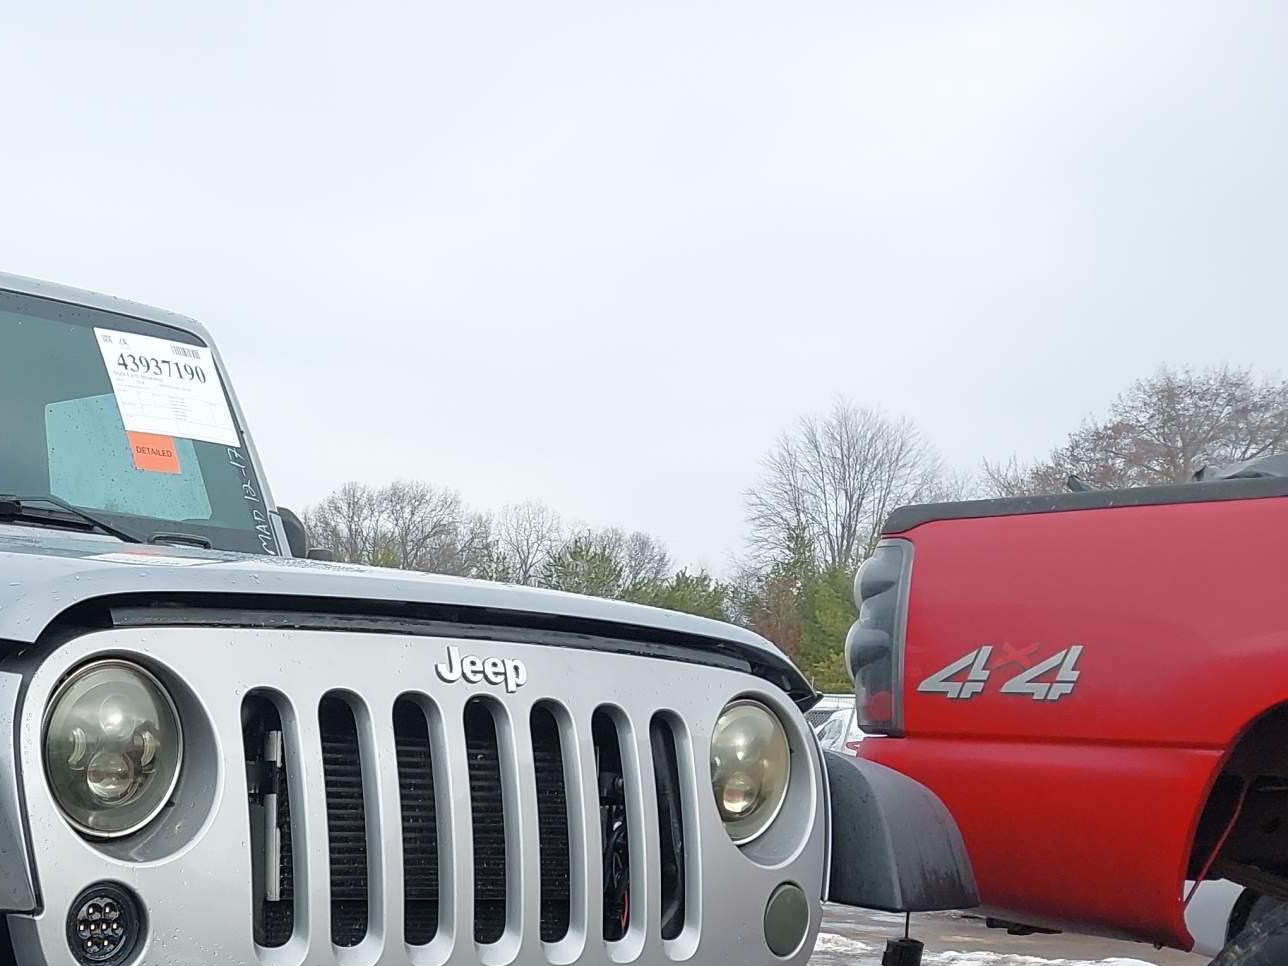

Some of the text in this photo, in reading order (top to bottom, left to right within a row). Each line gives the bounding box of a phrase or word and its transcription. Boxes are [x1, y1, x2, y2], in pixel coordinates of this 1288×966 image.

[117, 352, 207, 384] 43937190
[135, 446, 173, 458] DETAILED
[252, 509, 276, 555] MAD
[434, 645, 527, 694] Jeep
